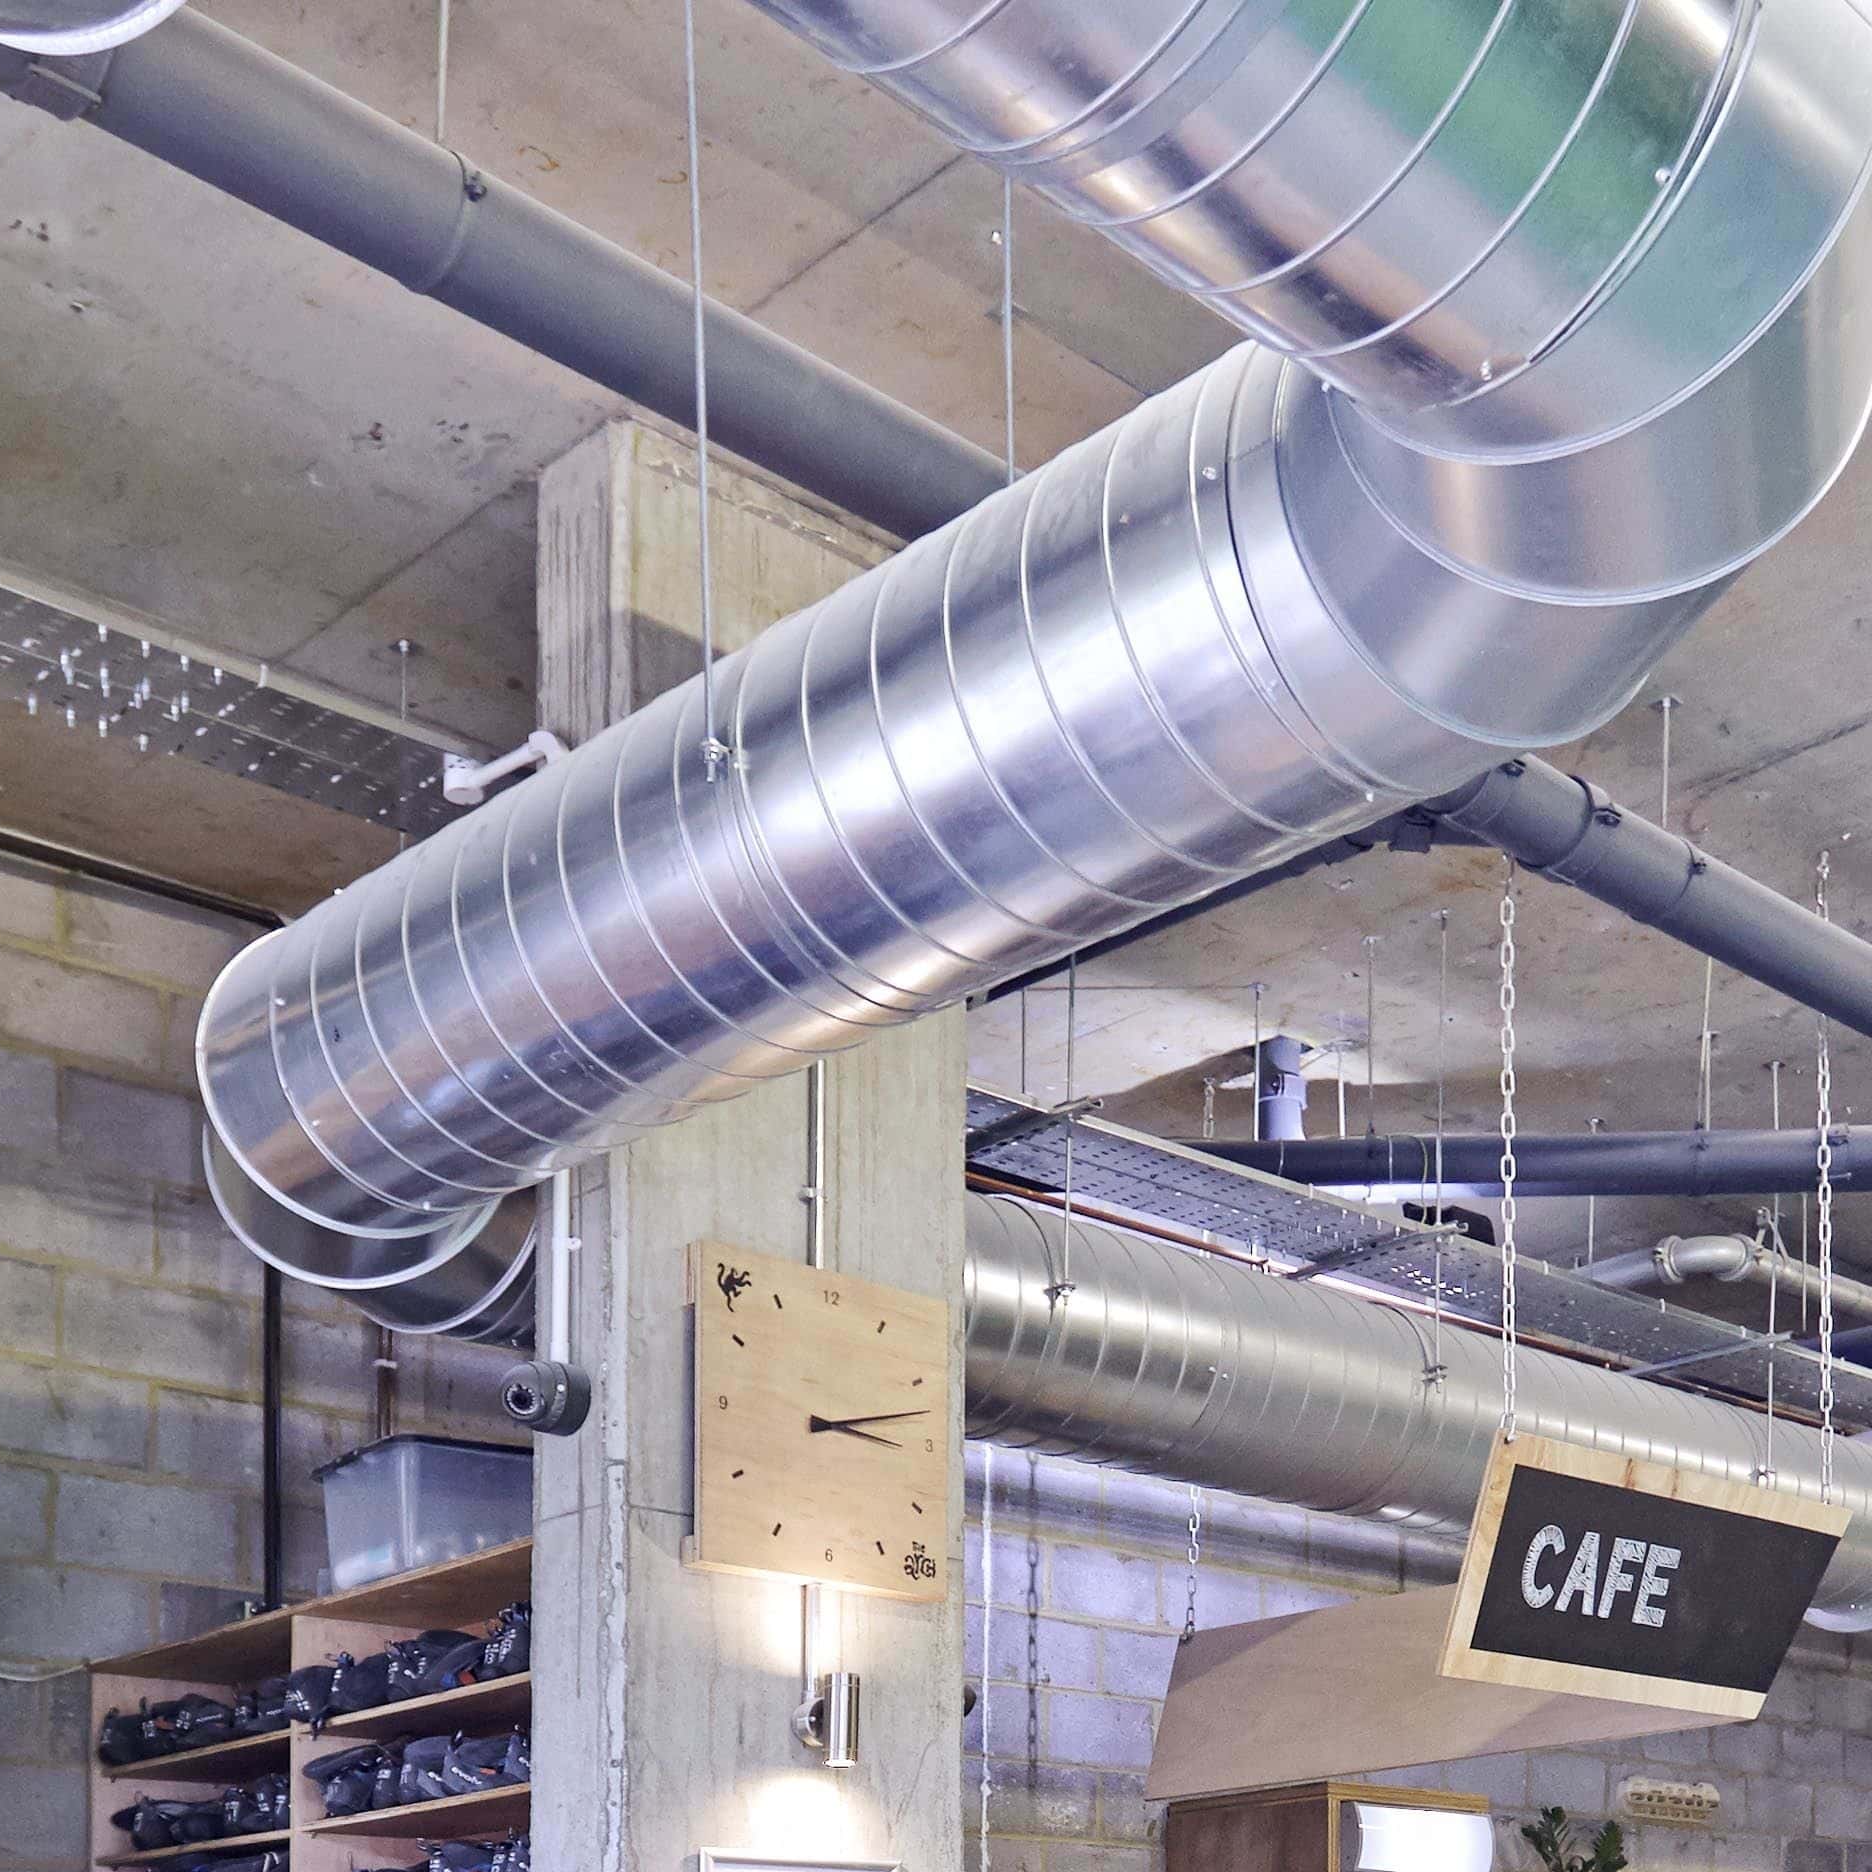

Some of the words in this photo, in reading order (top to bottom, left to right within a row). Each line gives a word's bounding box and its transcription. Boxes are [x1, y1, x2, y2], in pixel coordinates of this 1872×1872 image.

[822, 1290, 841, 1307] 12
[718, 1395, 728, 1411] 9
[925, 1439, 934, 1453] 3
[825, 1548, 834, 1562] 6
[1521, 1524, 1682, 1629] CAFE
